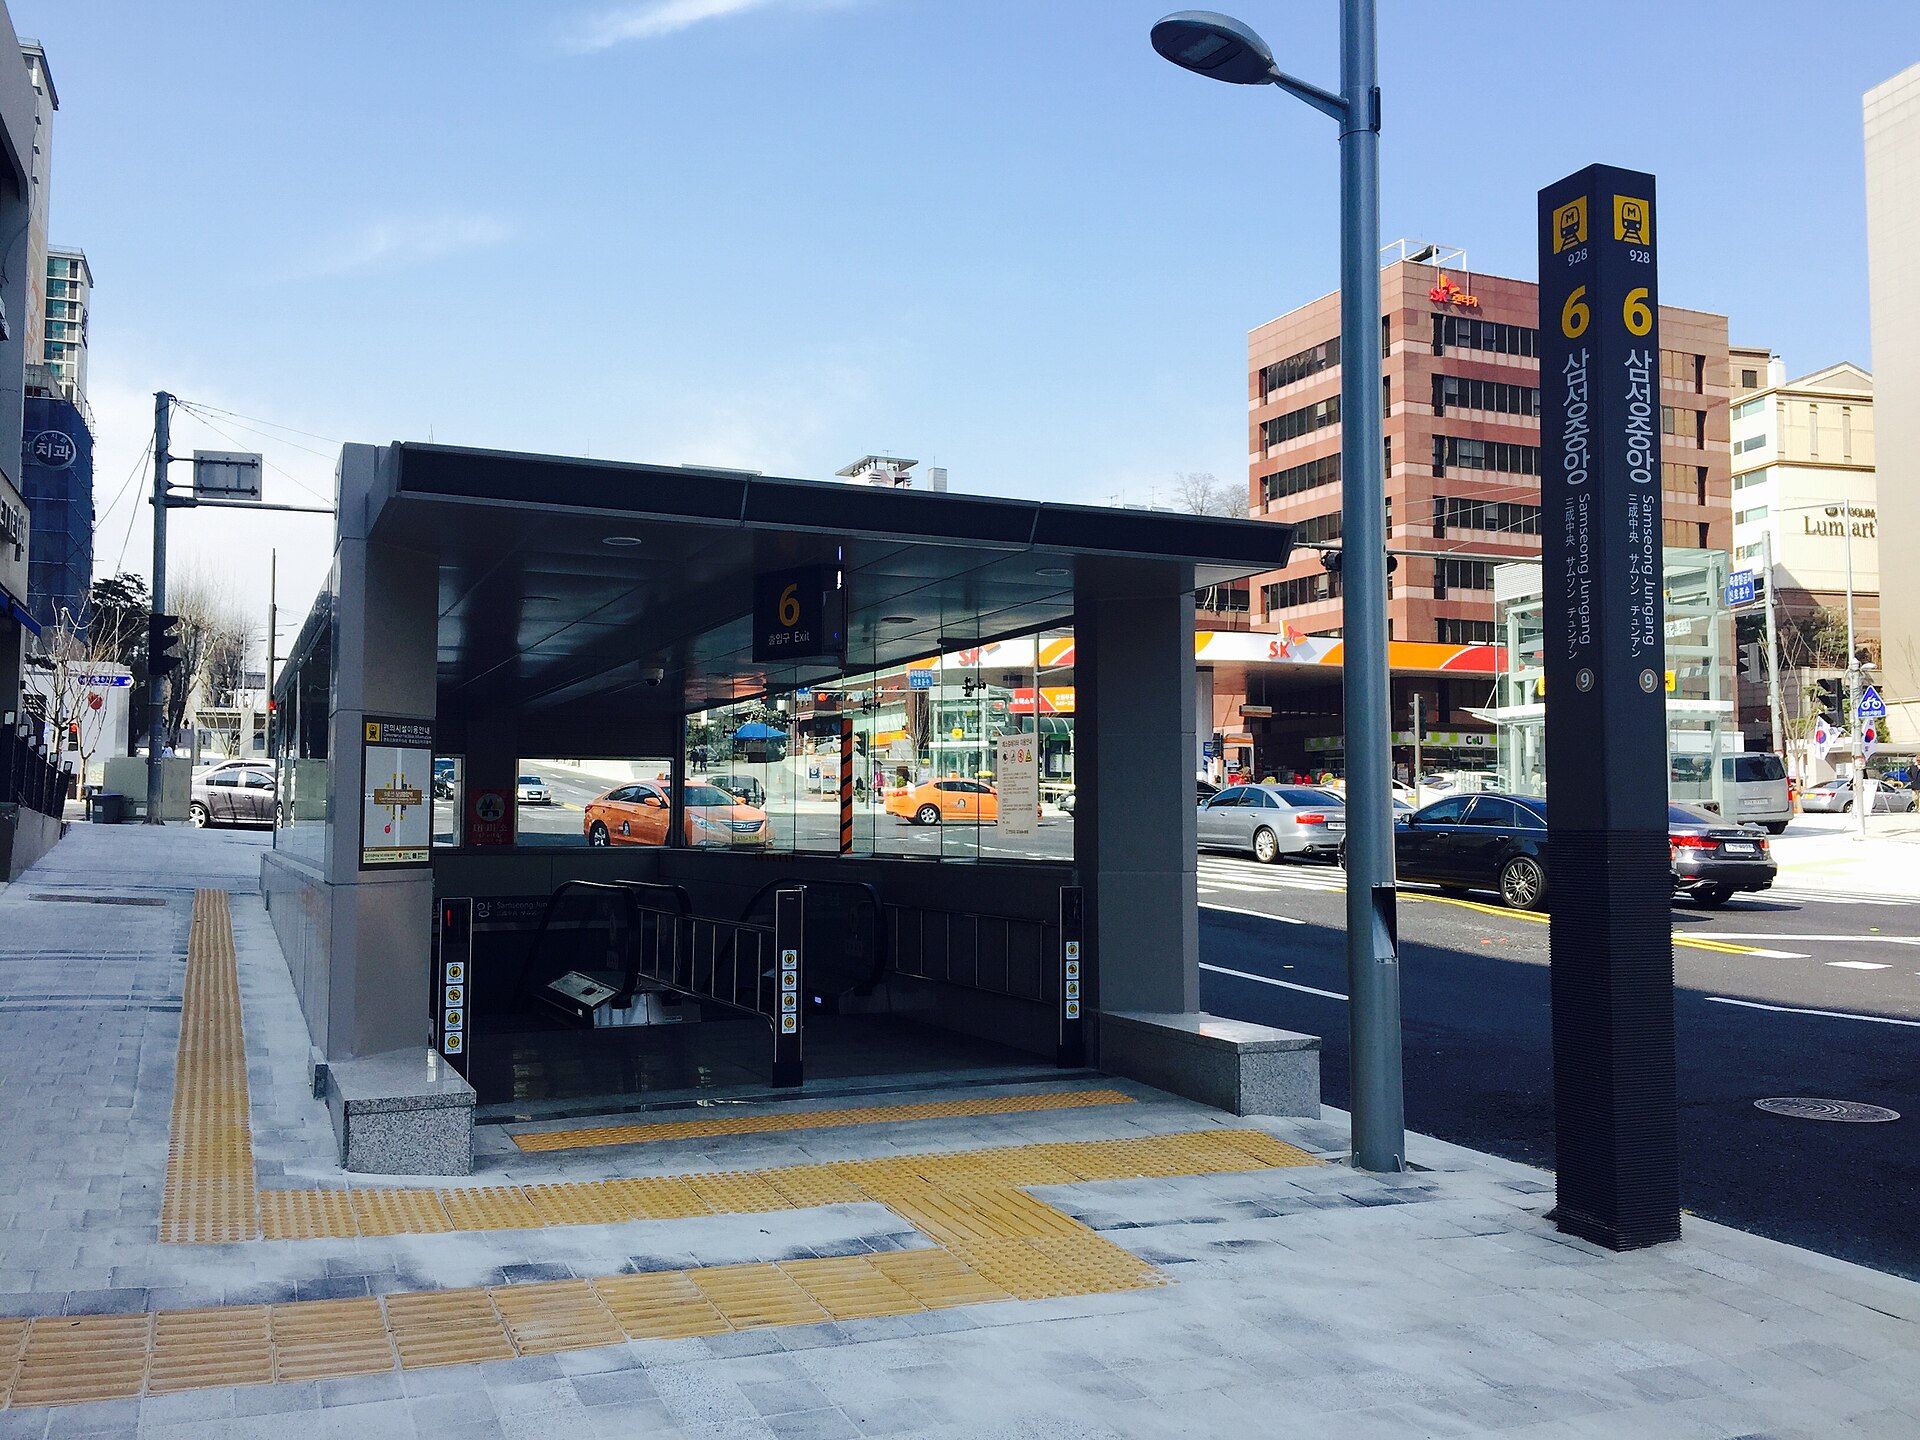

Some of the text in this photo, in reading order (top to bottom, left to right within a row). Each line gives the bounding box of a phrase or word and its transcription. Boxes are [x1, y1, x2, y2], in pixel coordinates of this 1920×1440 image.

[1565, 211, 1575, 224] M
[1627, 206, 1636, 218] M
[1567, 247, 1588, 267] 928
[1629, 249, 1650, 264] 928
[1561, 284, 1590, 339] 6
[1623, 287, 1653, 337] 6
[1562, 347, 1591, 485] 삼성중앙
[1623, 349, 1655, 484] 삼성중앙
[35, 442, 71, 461] 치과
[1565, 497, 1576, 548] 三成中央
[1628, 493, 1640, 544] 三成中央
[1804, 515, 1875, 539] Lumart
[1577, 493, 1592, 645] Samseong Jungang
[1641, 494, 1656, 646] Samseong Jungang
[779, 583, 800, 627] 6
[768, 631, 810, 646] 출입구 Exit
[1268, 641, 1291, 658] SK
[1580, 672, 1590, 688] 9
[1644, 673, 1654, 689] 9
[1465, 734, 1484, 746] CU
